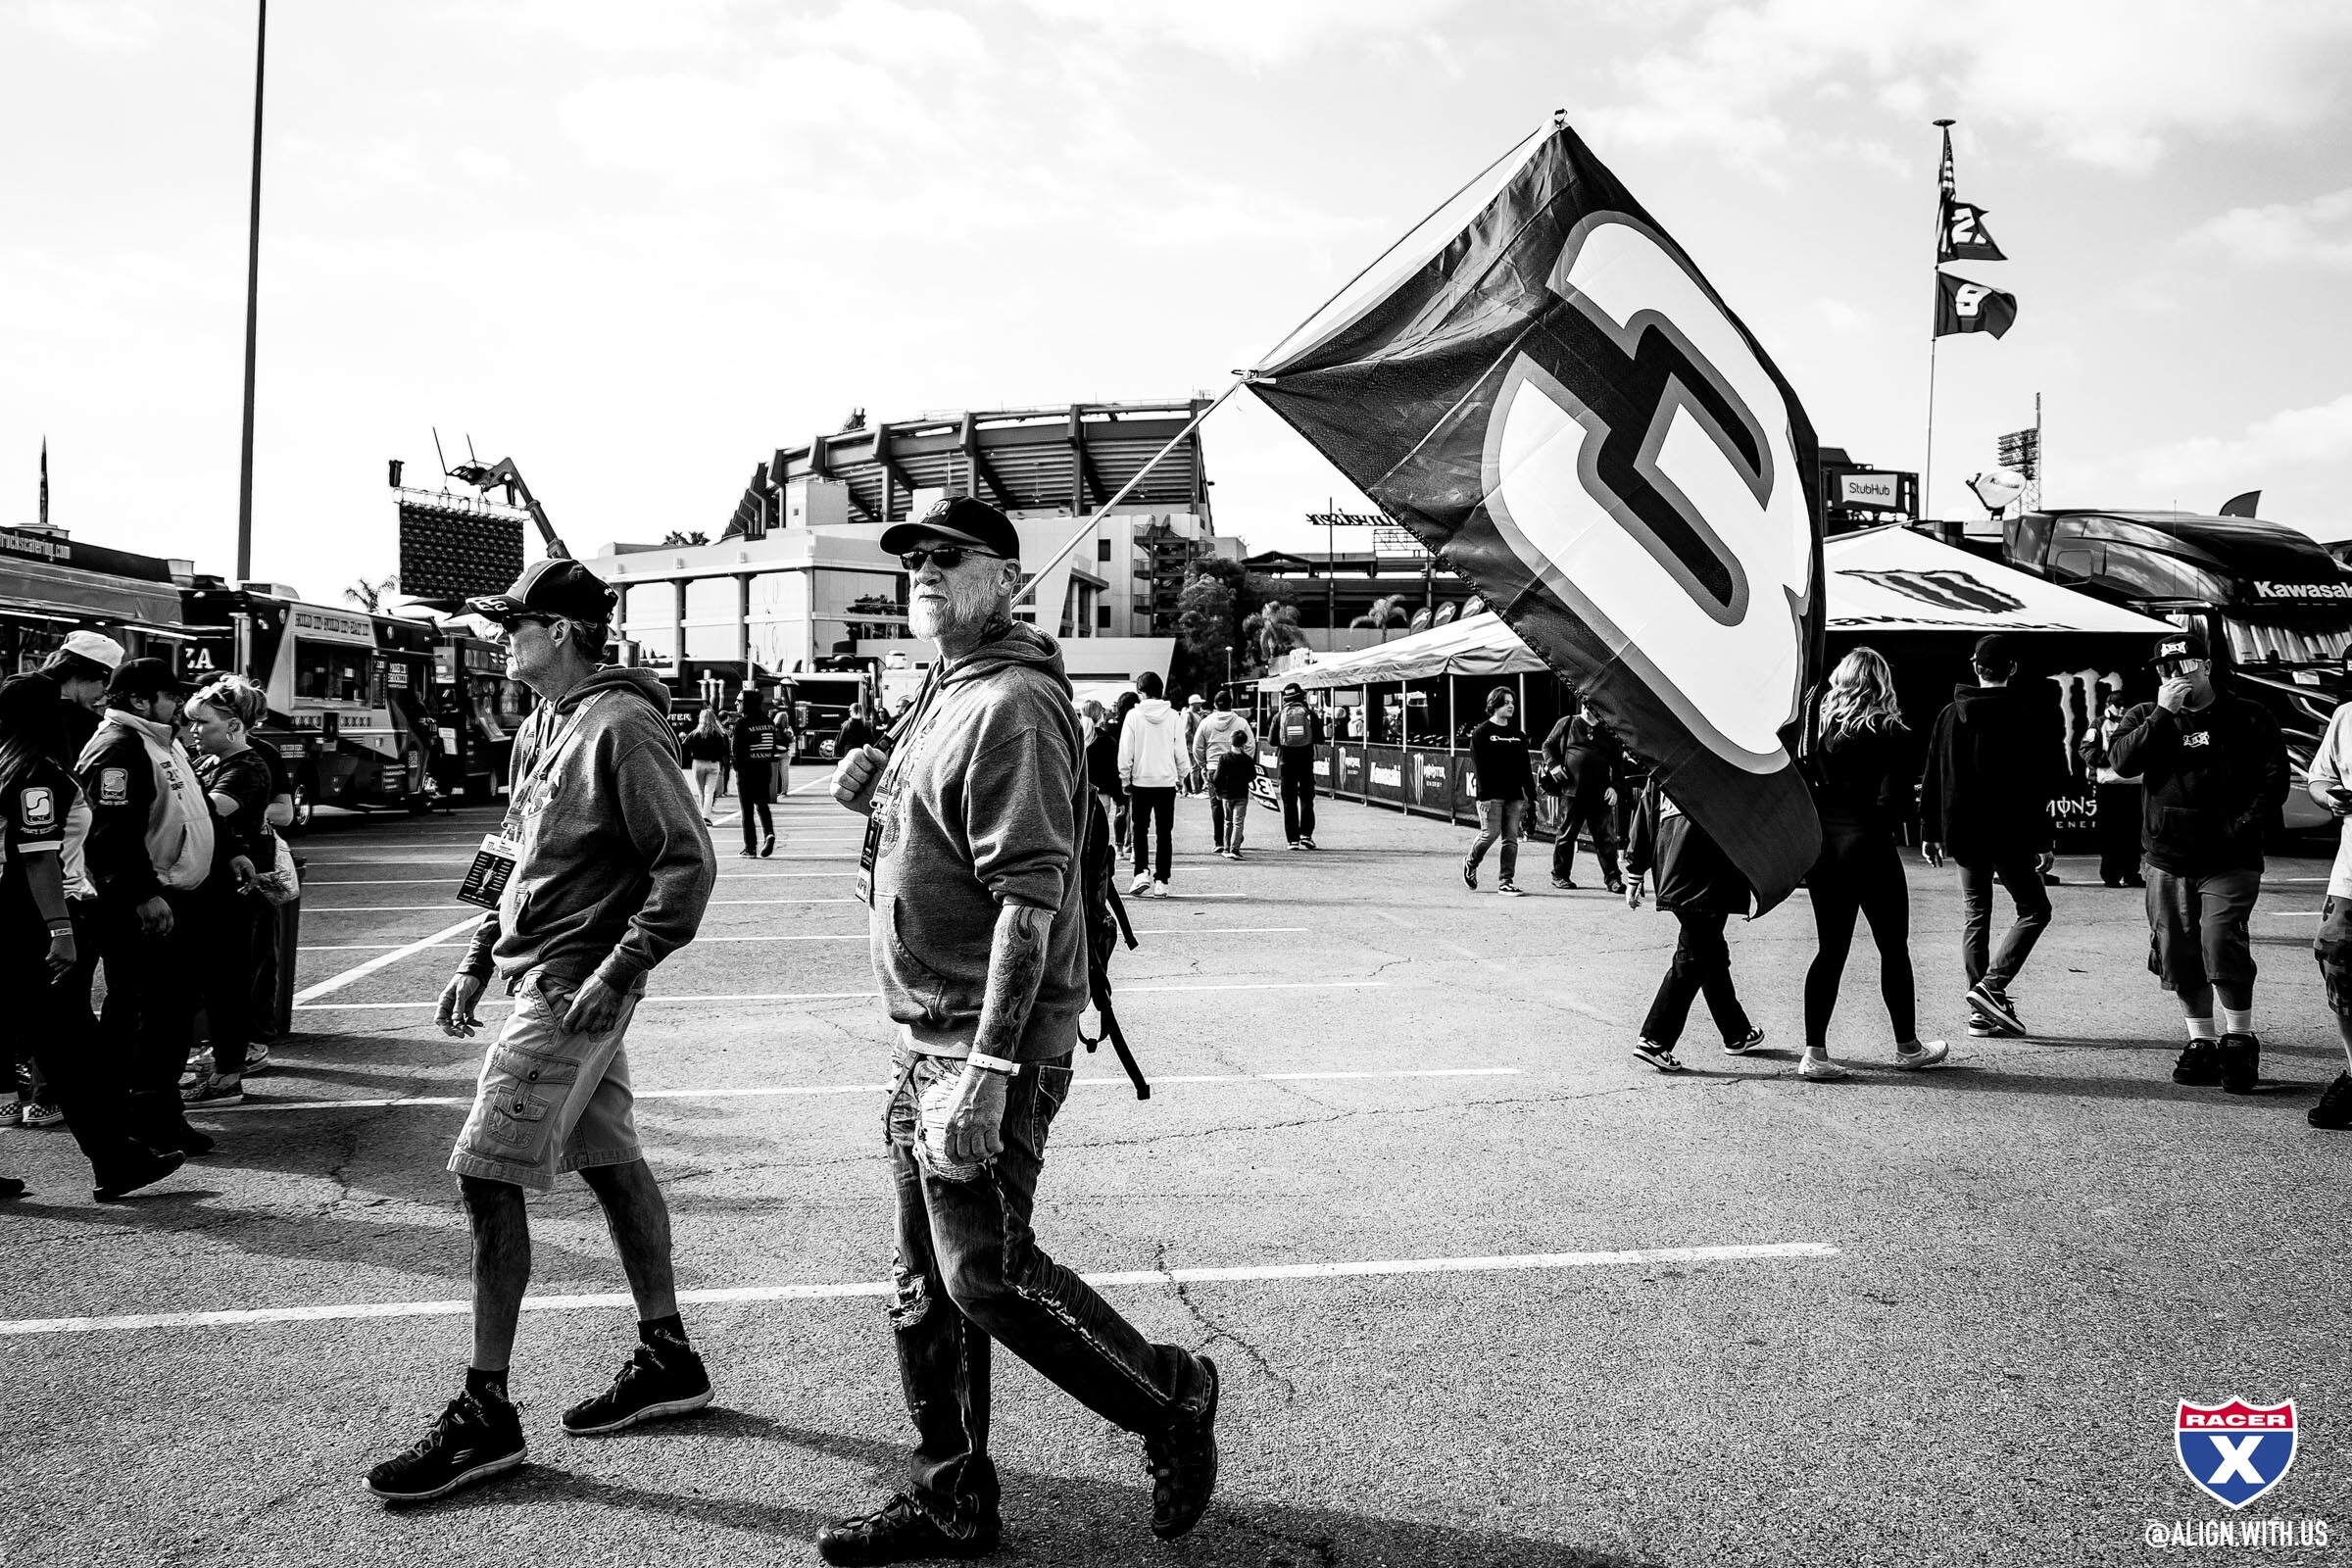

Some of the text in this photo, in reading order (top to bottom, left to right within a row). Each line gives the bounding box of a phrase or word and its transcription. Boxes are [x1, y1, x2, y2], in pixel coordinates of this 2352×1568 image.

[1483, 210, 1813, 774] 3
[1848, 481, 1890, 496] StubHub
[1369, 761, 1401, 788] Kawasaki
